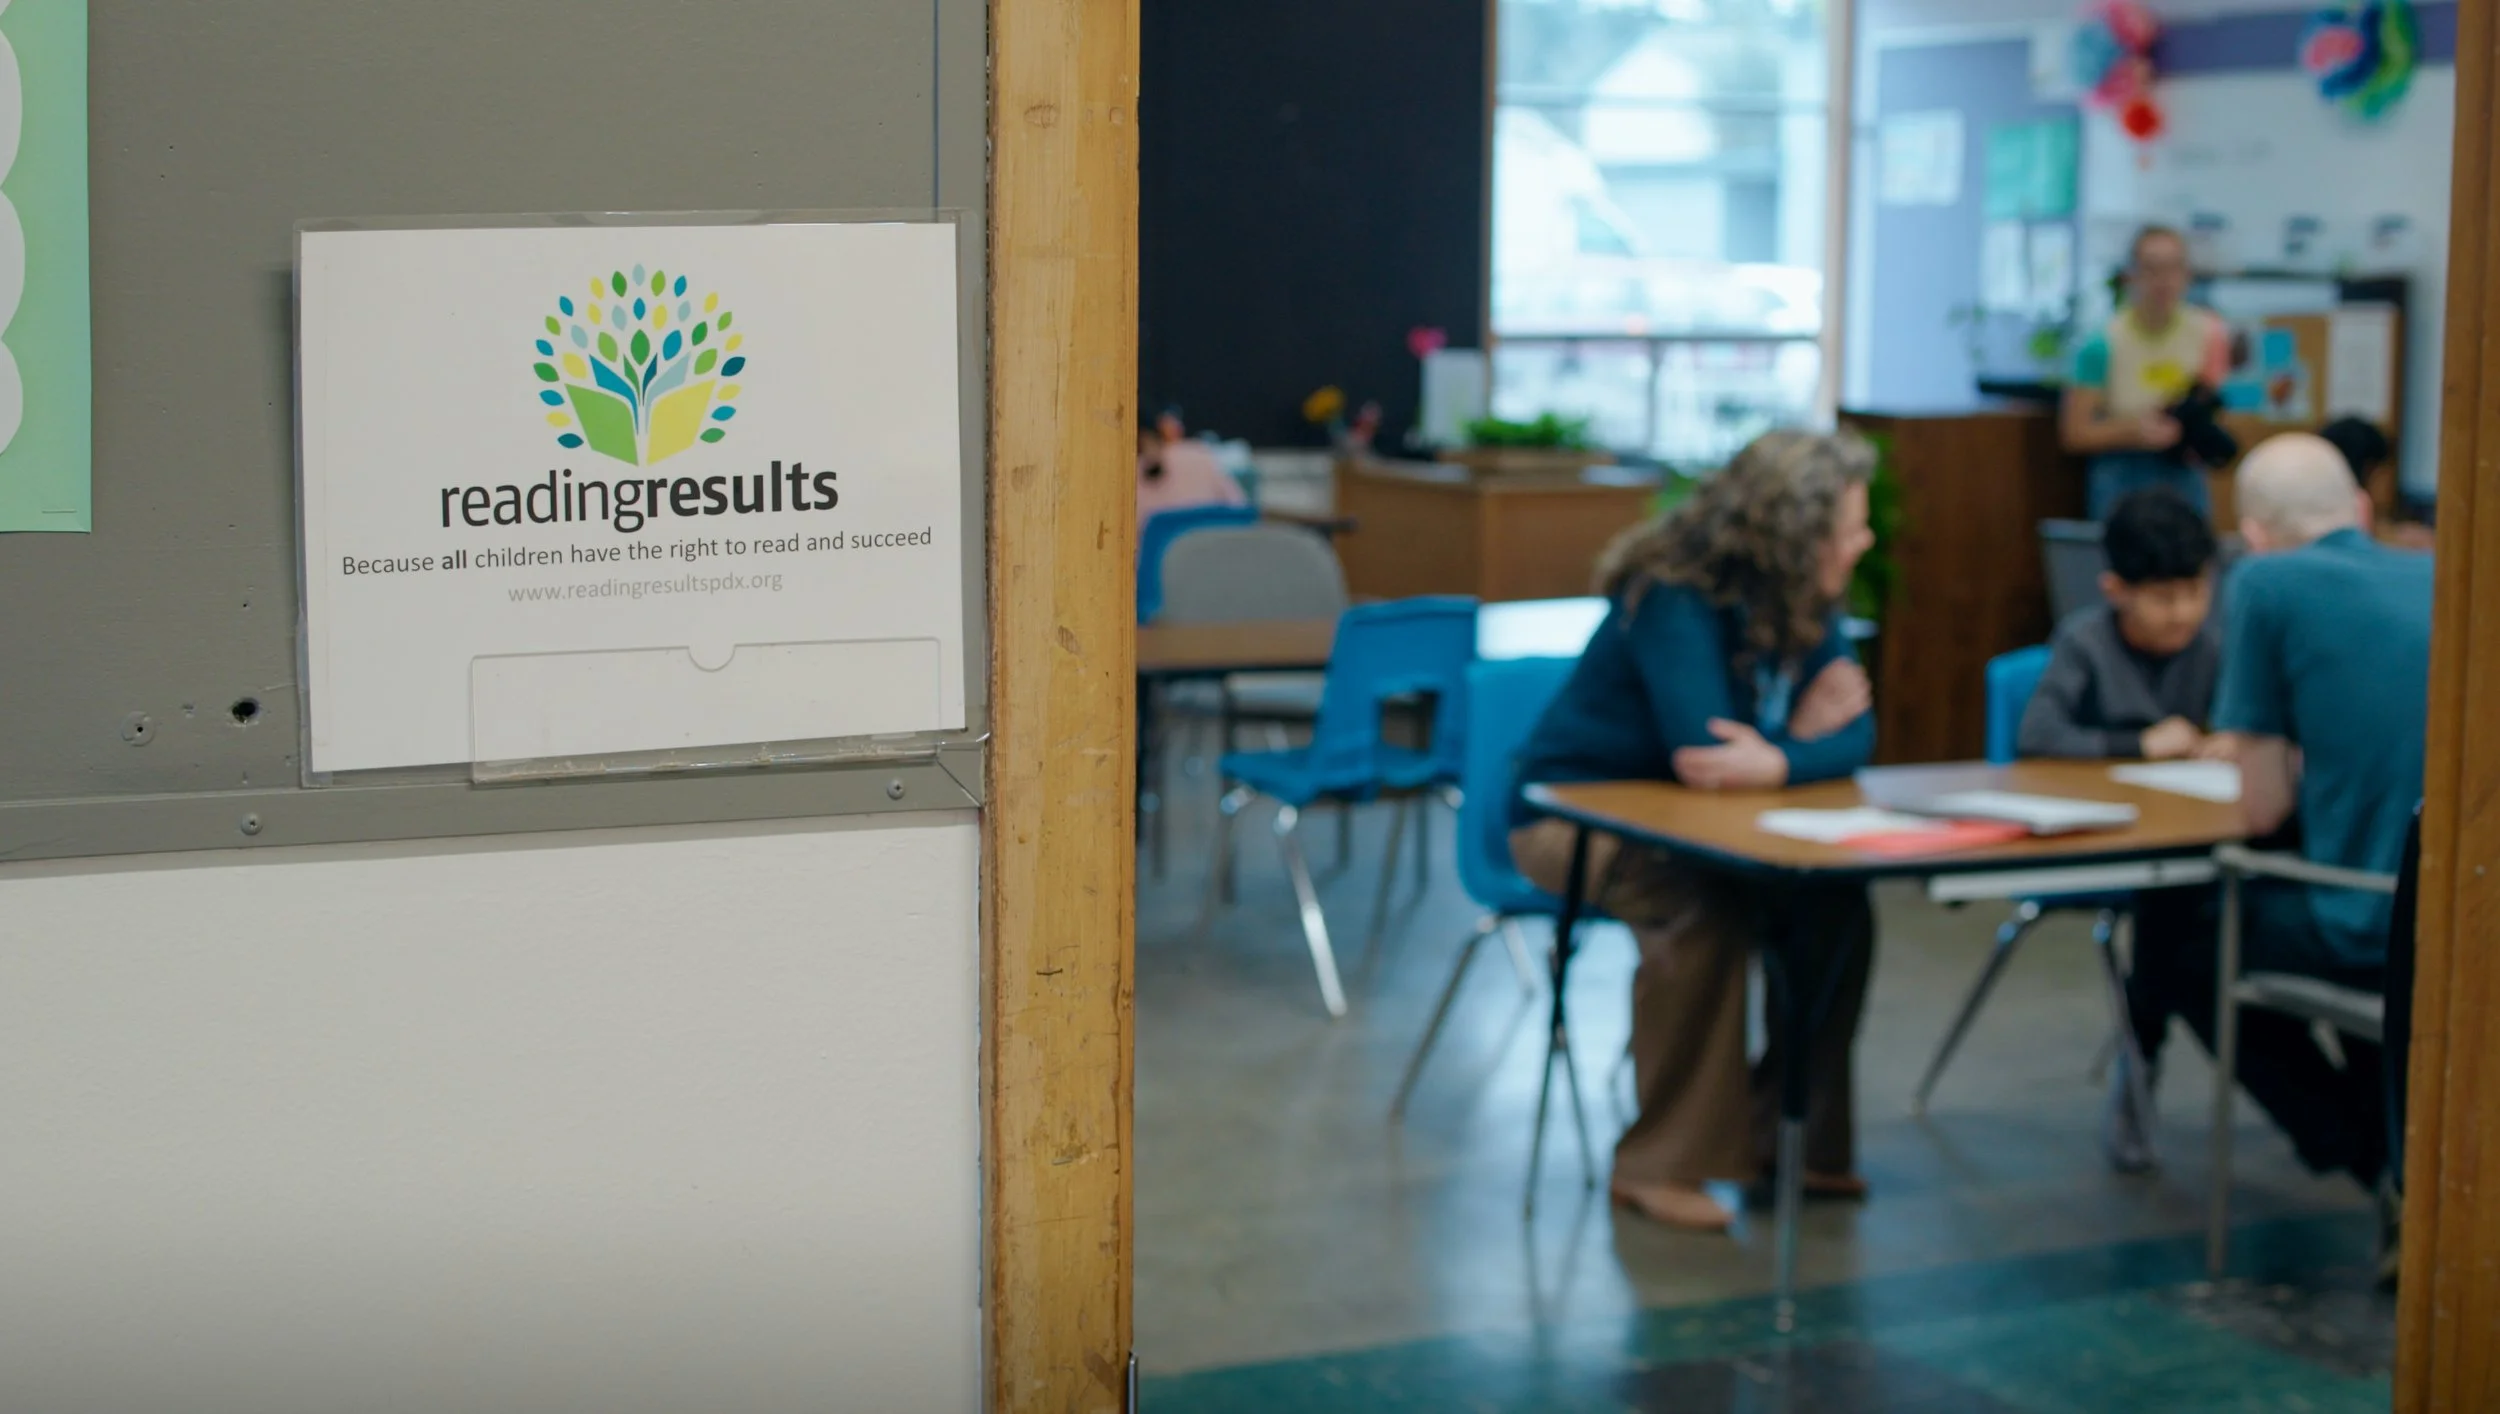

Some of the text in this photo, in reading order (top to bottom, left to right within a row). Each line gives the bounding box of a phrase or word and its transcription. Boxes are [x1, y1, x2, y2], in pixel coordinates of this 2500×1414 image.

[440, 460, 839, 533] readingresults
[342, 525, 933, 577] Because all children have the right to read and succeed
[508, 571, 784, 603] www.readingresultspdx.org
